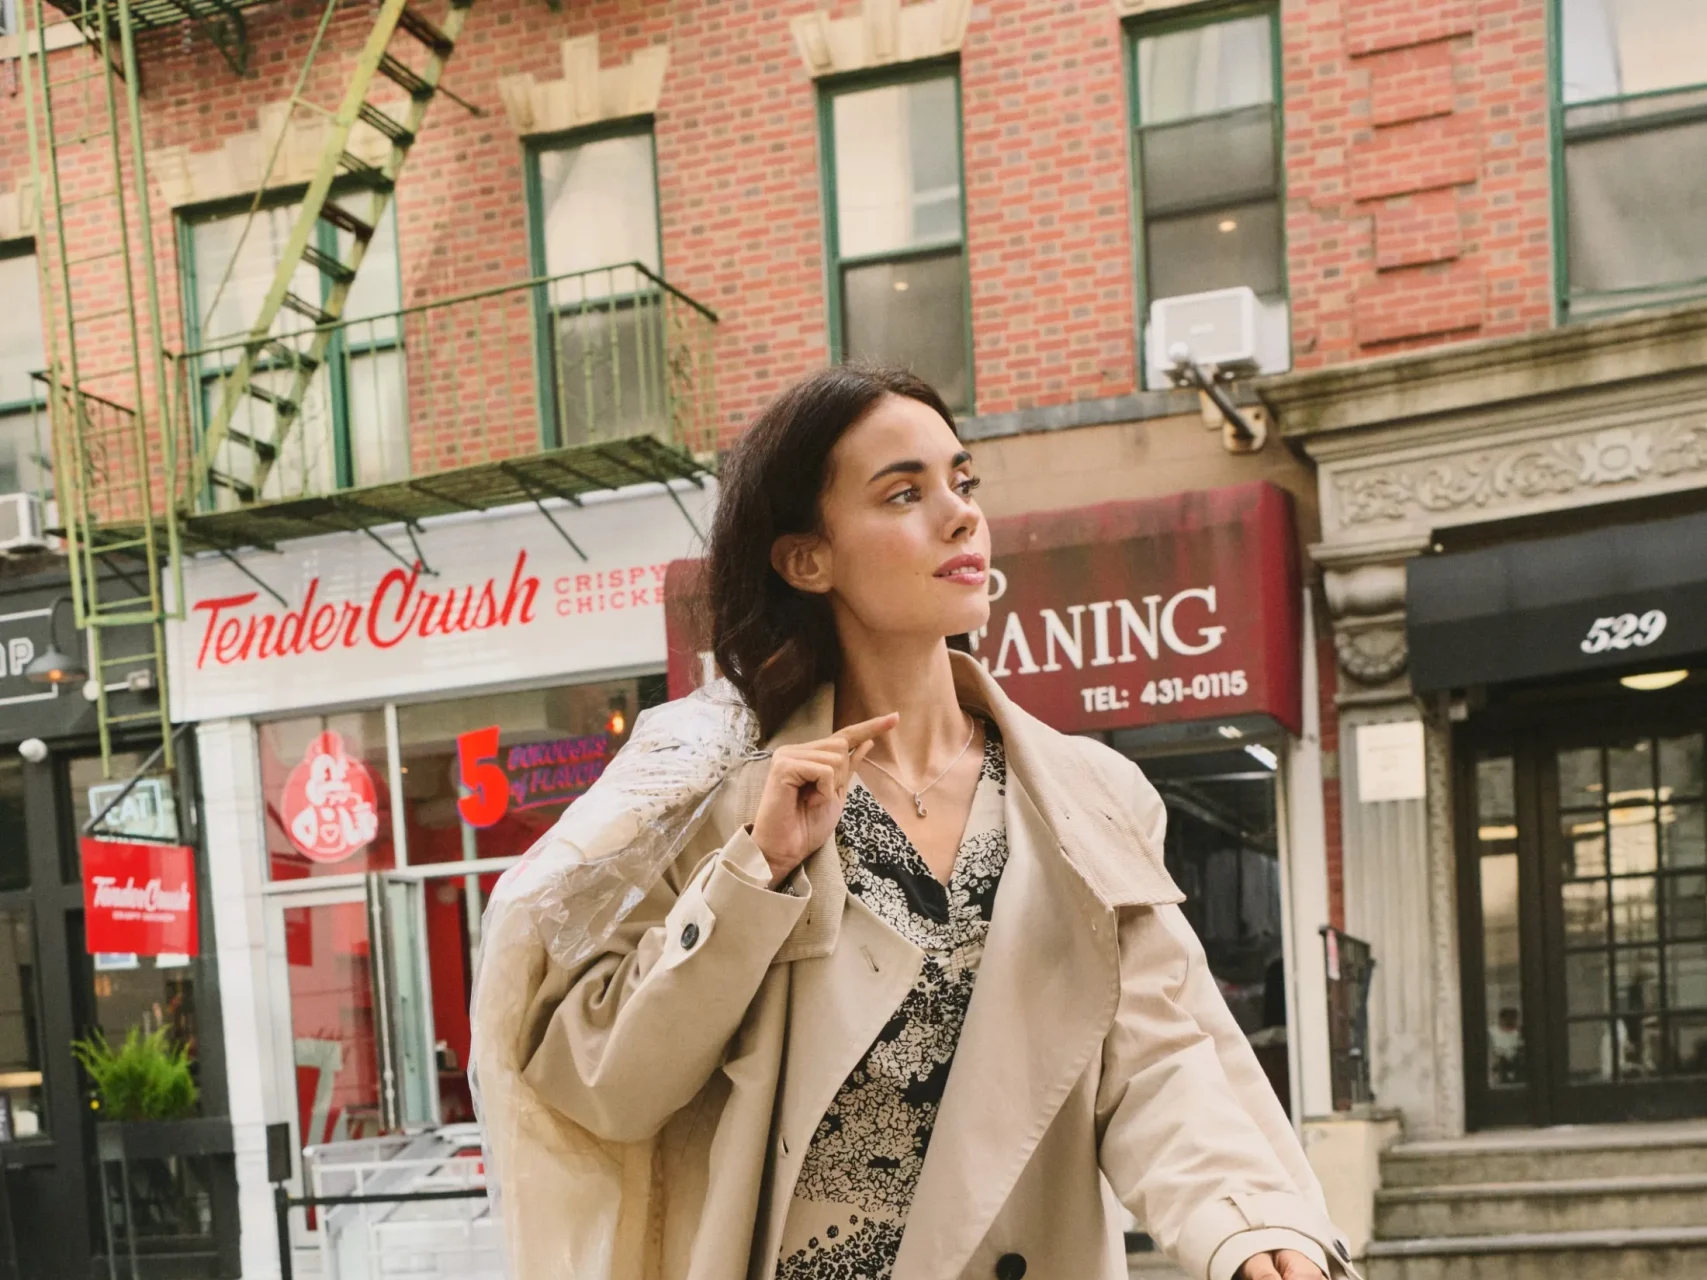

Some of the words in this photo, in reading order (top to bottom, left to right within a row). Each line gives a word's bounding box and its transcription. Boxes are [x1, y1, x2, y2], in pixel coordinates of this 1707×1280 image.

[554, 563, 668, 595] CRISPY
[192, 548, 541, 670] TenderCrush
[1580, 609, 1668, 654] 529
[1080, 685, 1130, 713] TEL:
[1140, 669, 1249, 706] 431-0115
